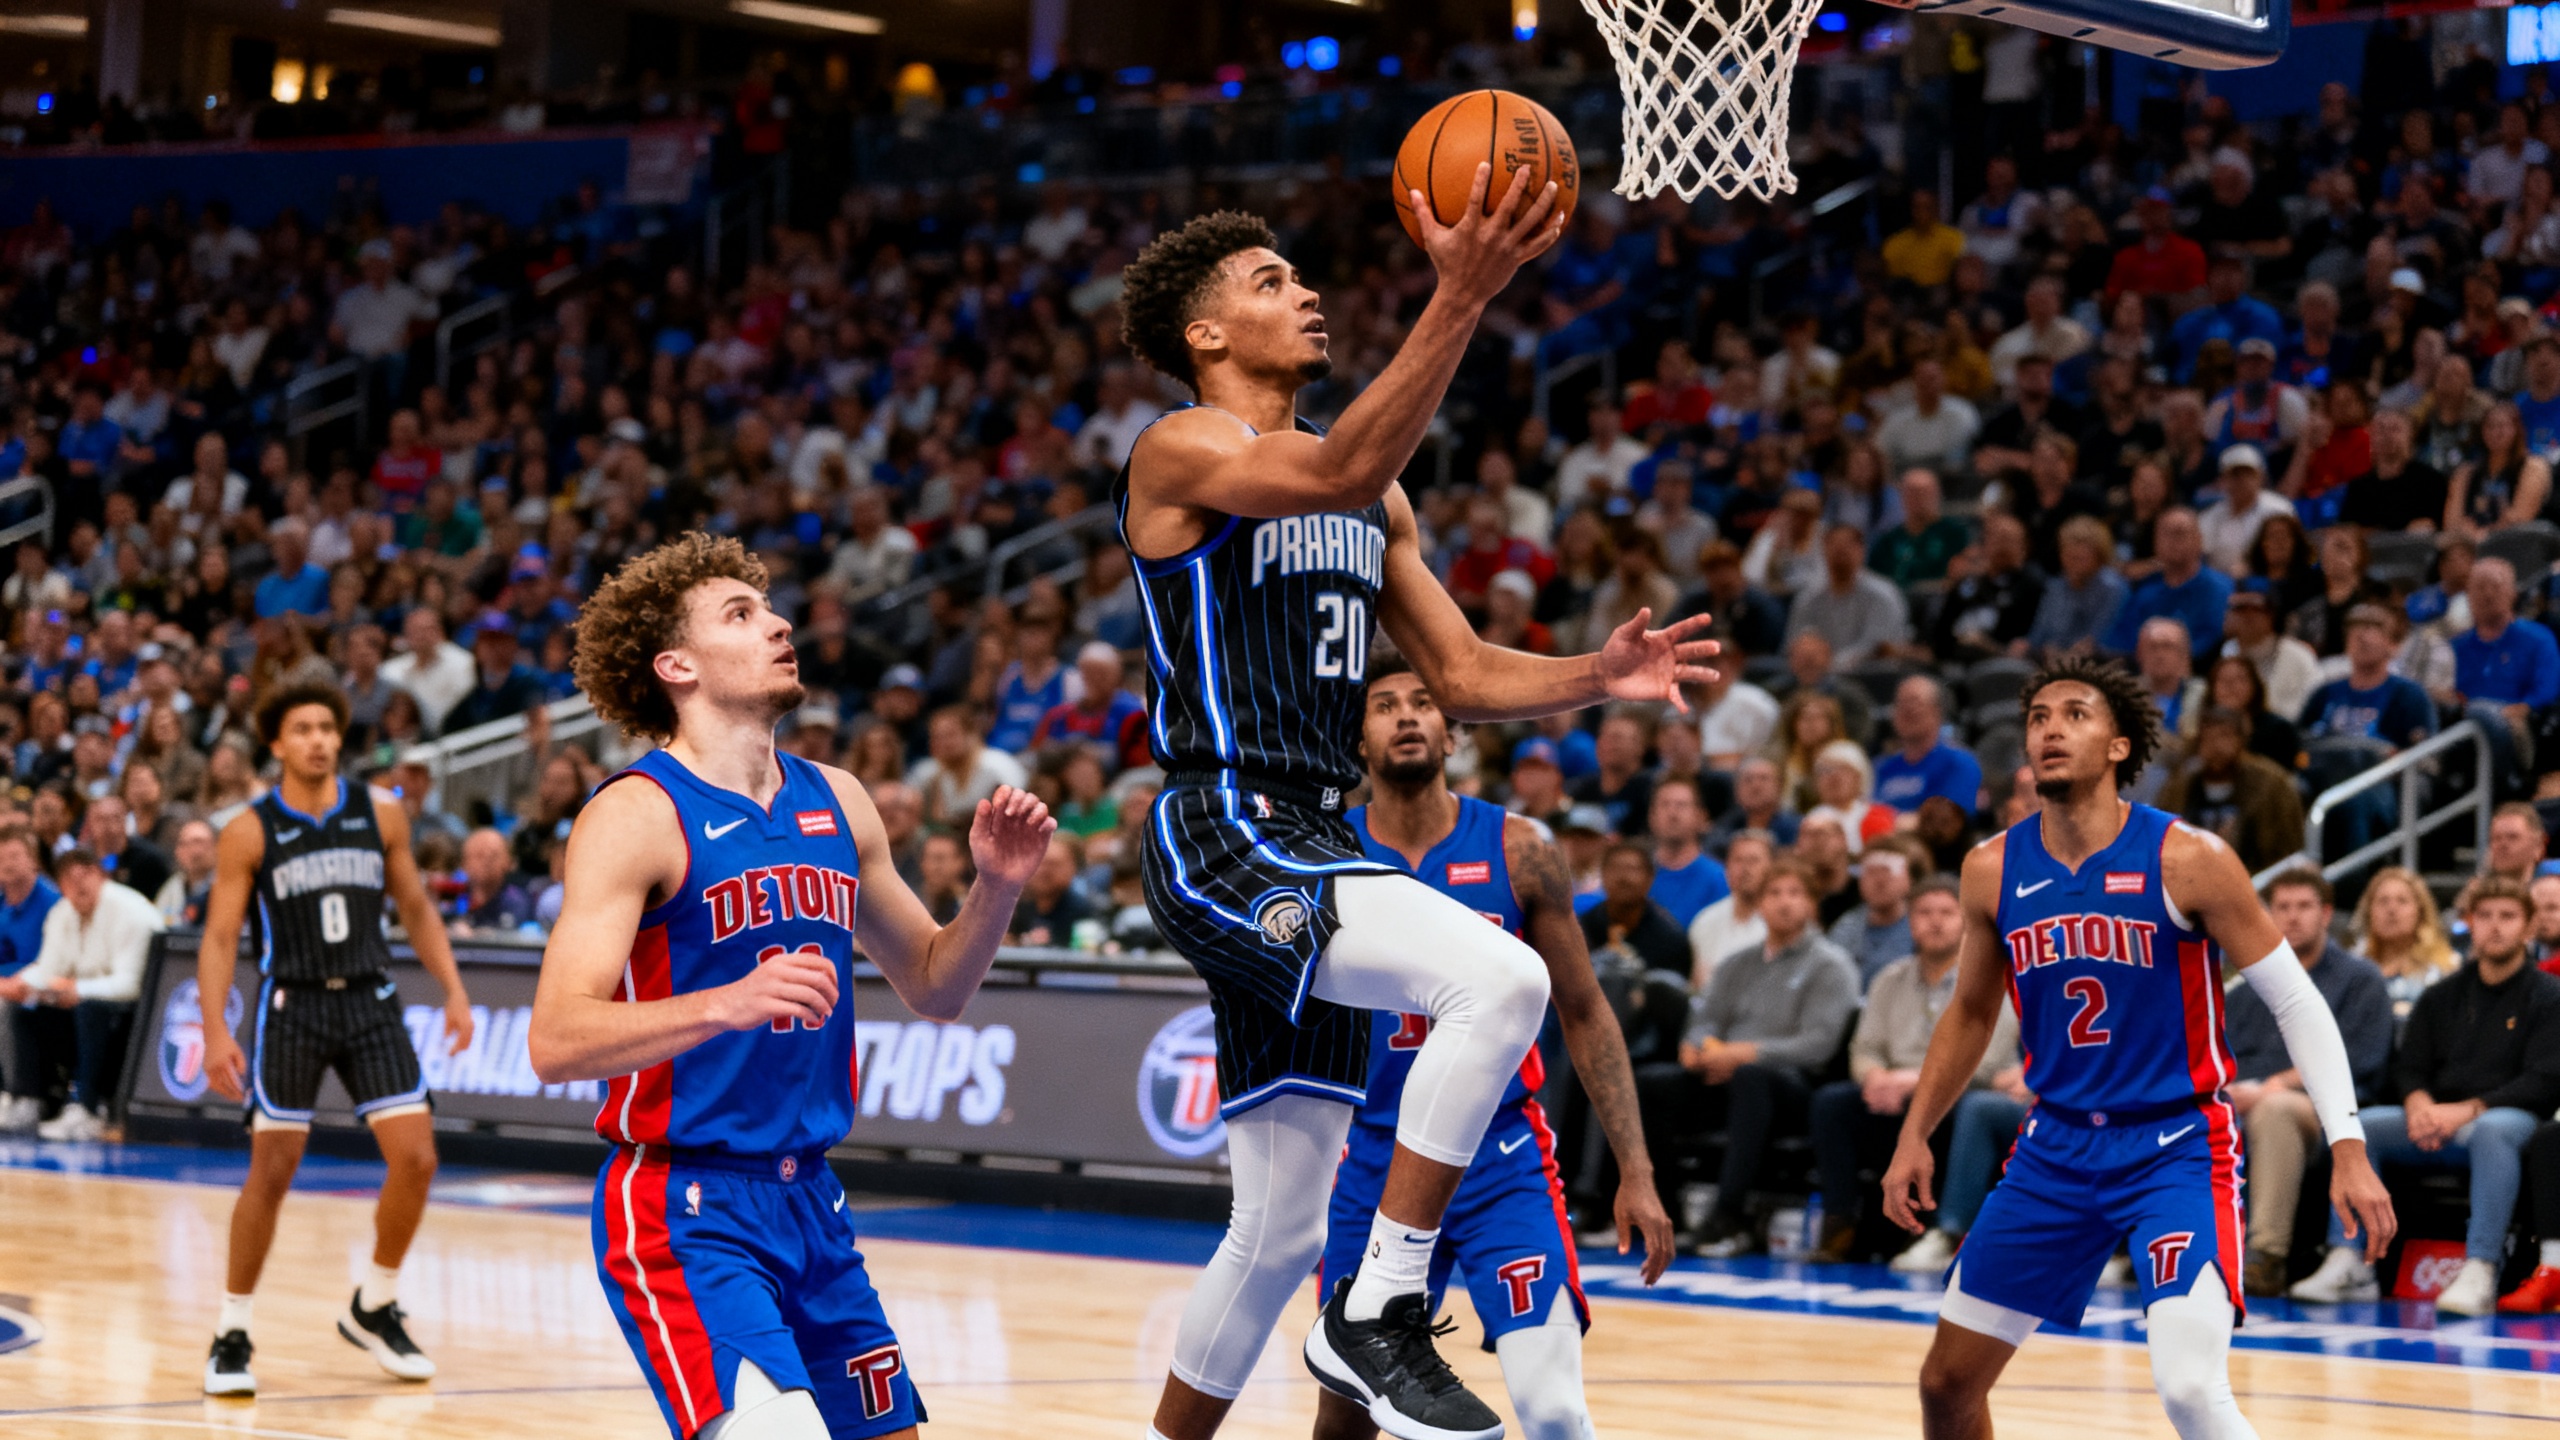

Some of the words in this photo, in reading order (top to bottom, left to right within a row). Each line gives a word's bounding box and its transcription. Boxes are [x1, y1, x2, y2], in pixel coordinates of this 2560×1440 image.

[1314, 591, 1367, 685] 20
[702, 863, 860, 944] DETOIT
[2005, 911, 2158, 976] DETOIT
[2064, 976, 2111, 1049] 2
